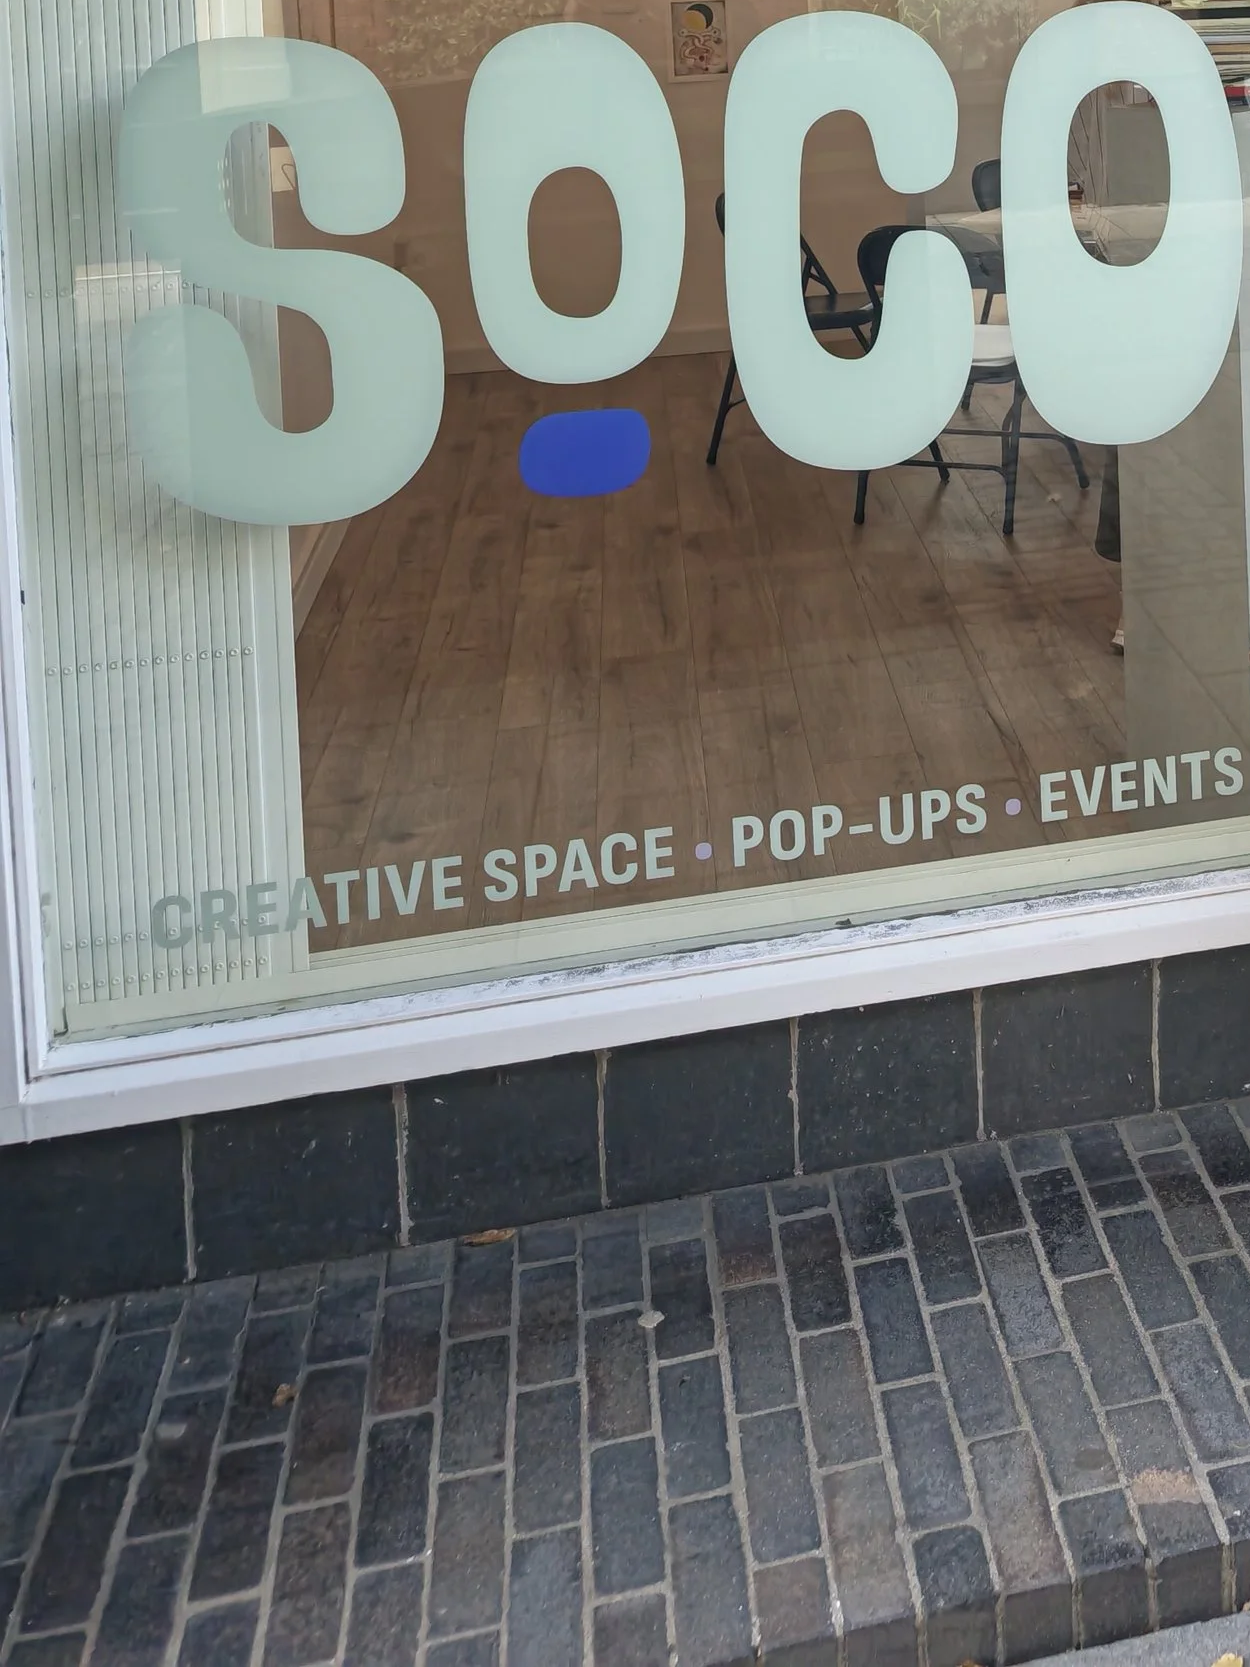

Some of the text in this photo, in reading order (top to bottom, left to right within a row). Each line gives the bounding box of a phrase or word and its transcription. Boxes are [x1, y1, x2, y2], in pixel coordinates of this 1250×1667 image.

[151, 746, 1244, 950] CREATIVE SPACE POP-UPS EVENTS
